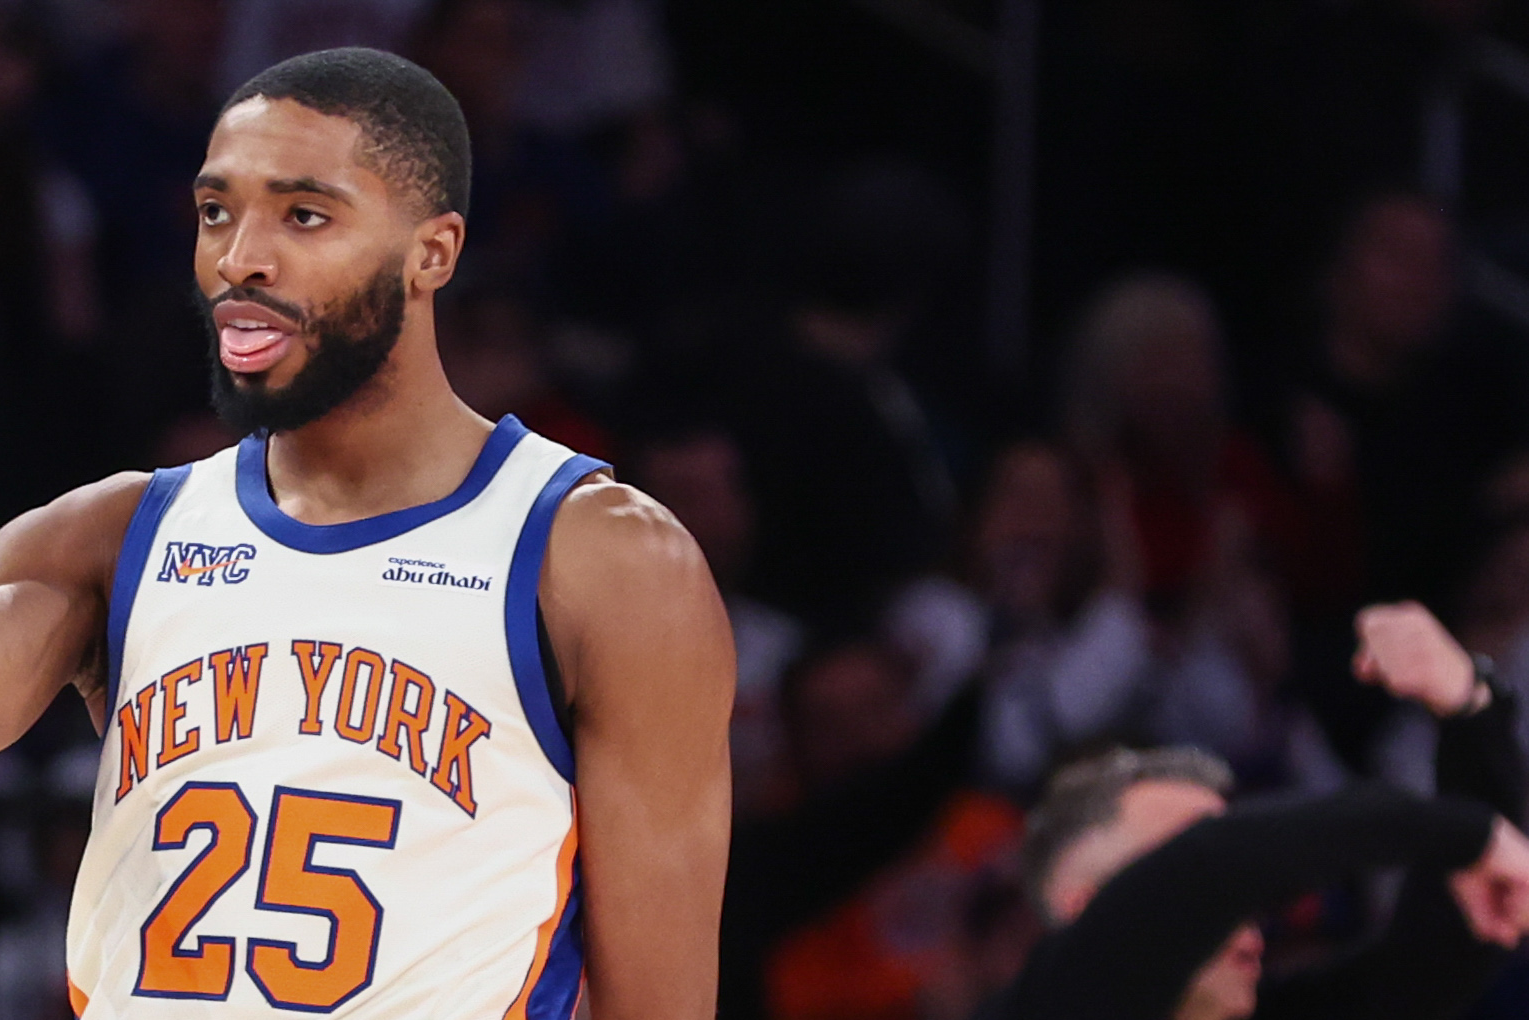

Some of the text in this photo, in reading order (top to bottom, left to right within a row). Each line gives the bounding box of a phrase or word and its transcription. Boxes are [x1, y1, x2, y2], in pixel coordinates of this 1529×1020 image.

[156, 541, 257, 587] NYC
[382, 567, 493, 591] abu dhabi
[388, 557, 446, 569] experience
[114, 639, 493, 820] NEW YORK
[131, 780, 403, 1015] 25
